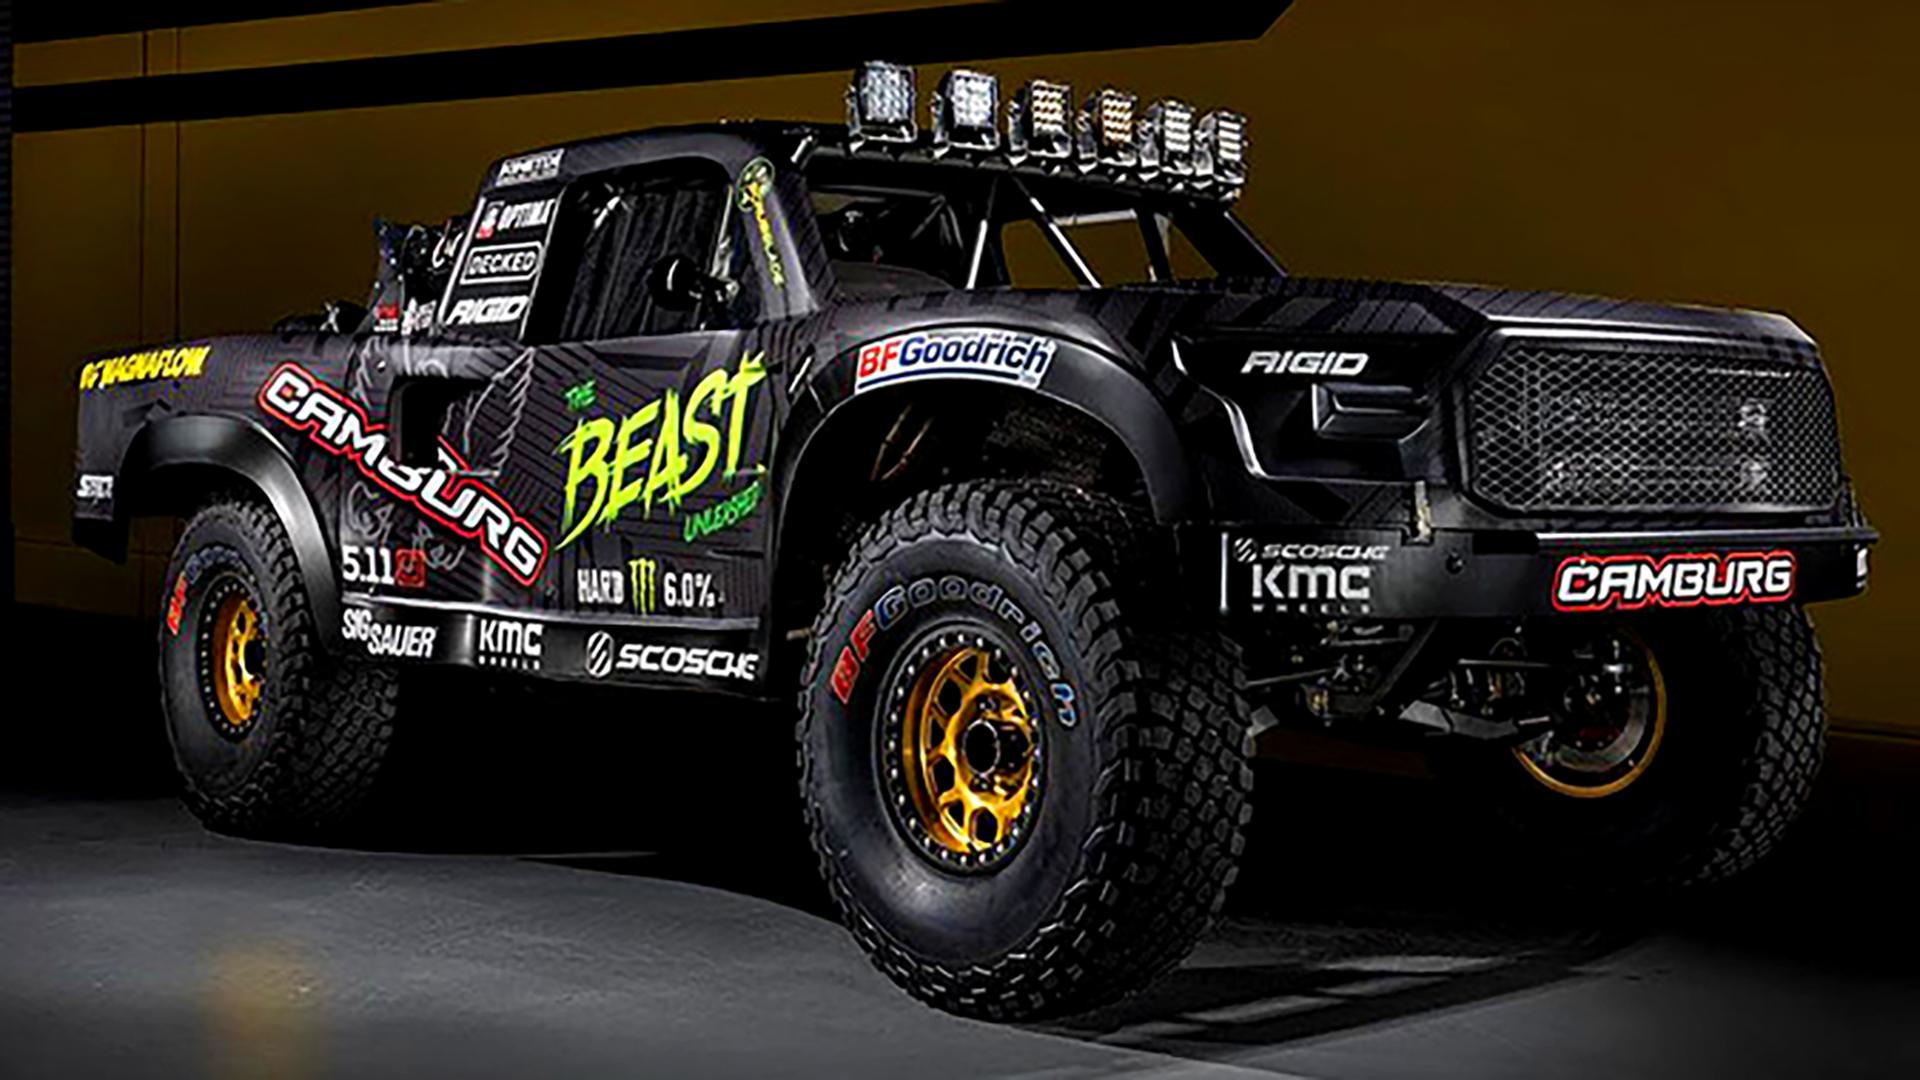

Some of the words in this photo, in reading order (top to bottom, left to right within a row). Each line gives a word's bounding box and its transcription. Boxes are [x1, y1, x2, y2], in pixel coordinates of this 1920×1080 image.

[468, 251, 538, 275] DECKED
[445, 295, 530, 325] RIGID
[859, 335, 1049, 378] BFGoodrich
[1240, 350, 1370, 376] RIGID
[552, 350, 768, 550] BEAST
[342, 545, 395, 584] 5.11
[1260, 543, 1391, 561] SCOSCHE
[577, 569, 625, 605] HARD
[664, 572, 716, 607] 6.0%
[1252, 564, 1371, 599] KMC
[1557, 559, 1793, 601] CAMBURG
[342, 608, 372, 641] SIG
[367, 624, 438, 658] SAUER
[479, 618, 545, 656] KMC
[830, 575, 1077, 727] BFGoodrich
[615, 643, 760, 681] SCOSCHE
